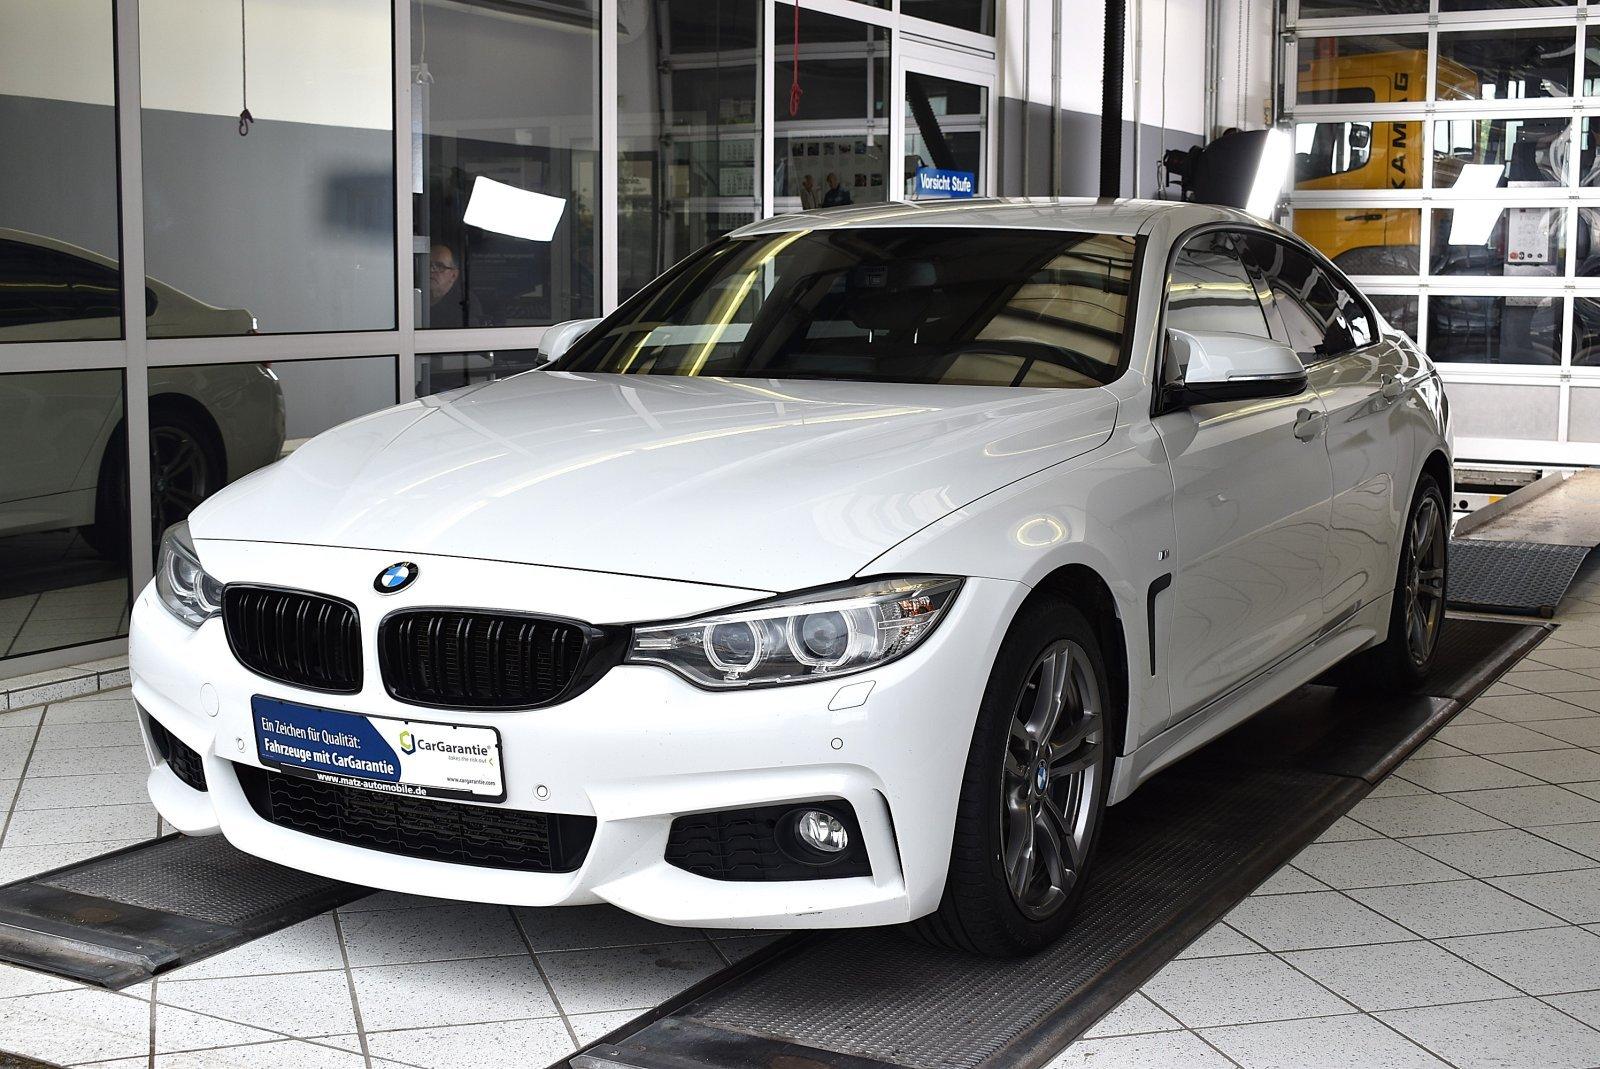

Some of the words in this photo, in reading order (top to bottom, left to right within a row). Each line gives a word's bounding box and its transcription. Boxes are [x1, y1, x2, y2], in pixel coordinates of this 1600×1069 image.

[1391, 72, 1409, 189] KAMG
[920, 173, 951, 191] Vorsicht
[951, 175, 972, 193] Stufe
[261, 717, 274, 732] Ein
[275, 720, 306, 739] Zeichen
[307, 727, 321, 742] für
[321, 729, 361, 749] Qualität:
[264, 738, 312, 763] Fahrzeuge
[313, 750, 331, 764] mit
[331, 752, 394, 775] CarGarantie
[316, 773, 427, 796] www.matz-automobile.de
